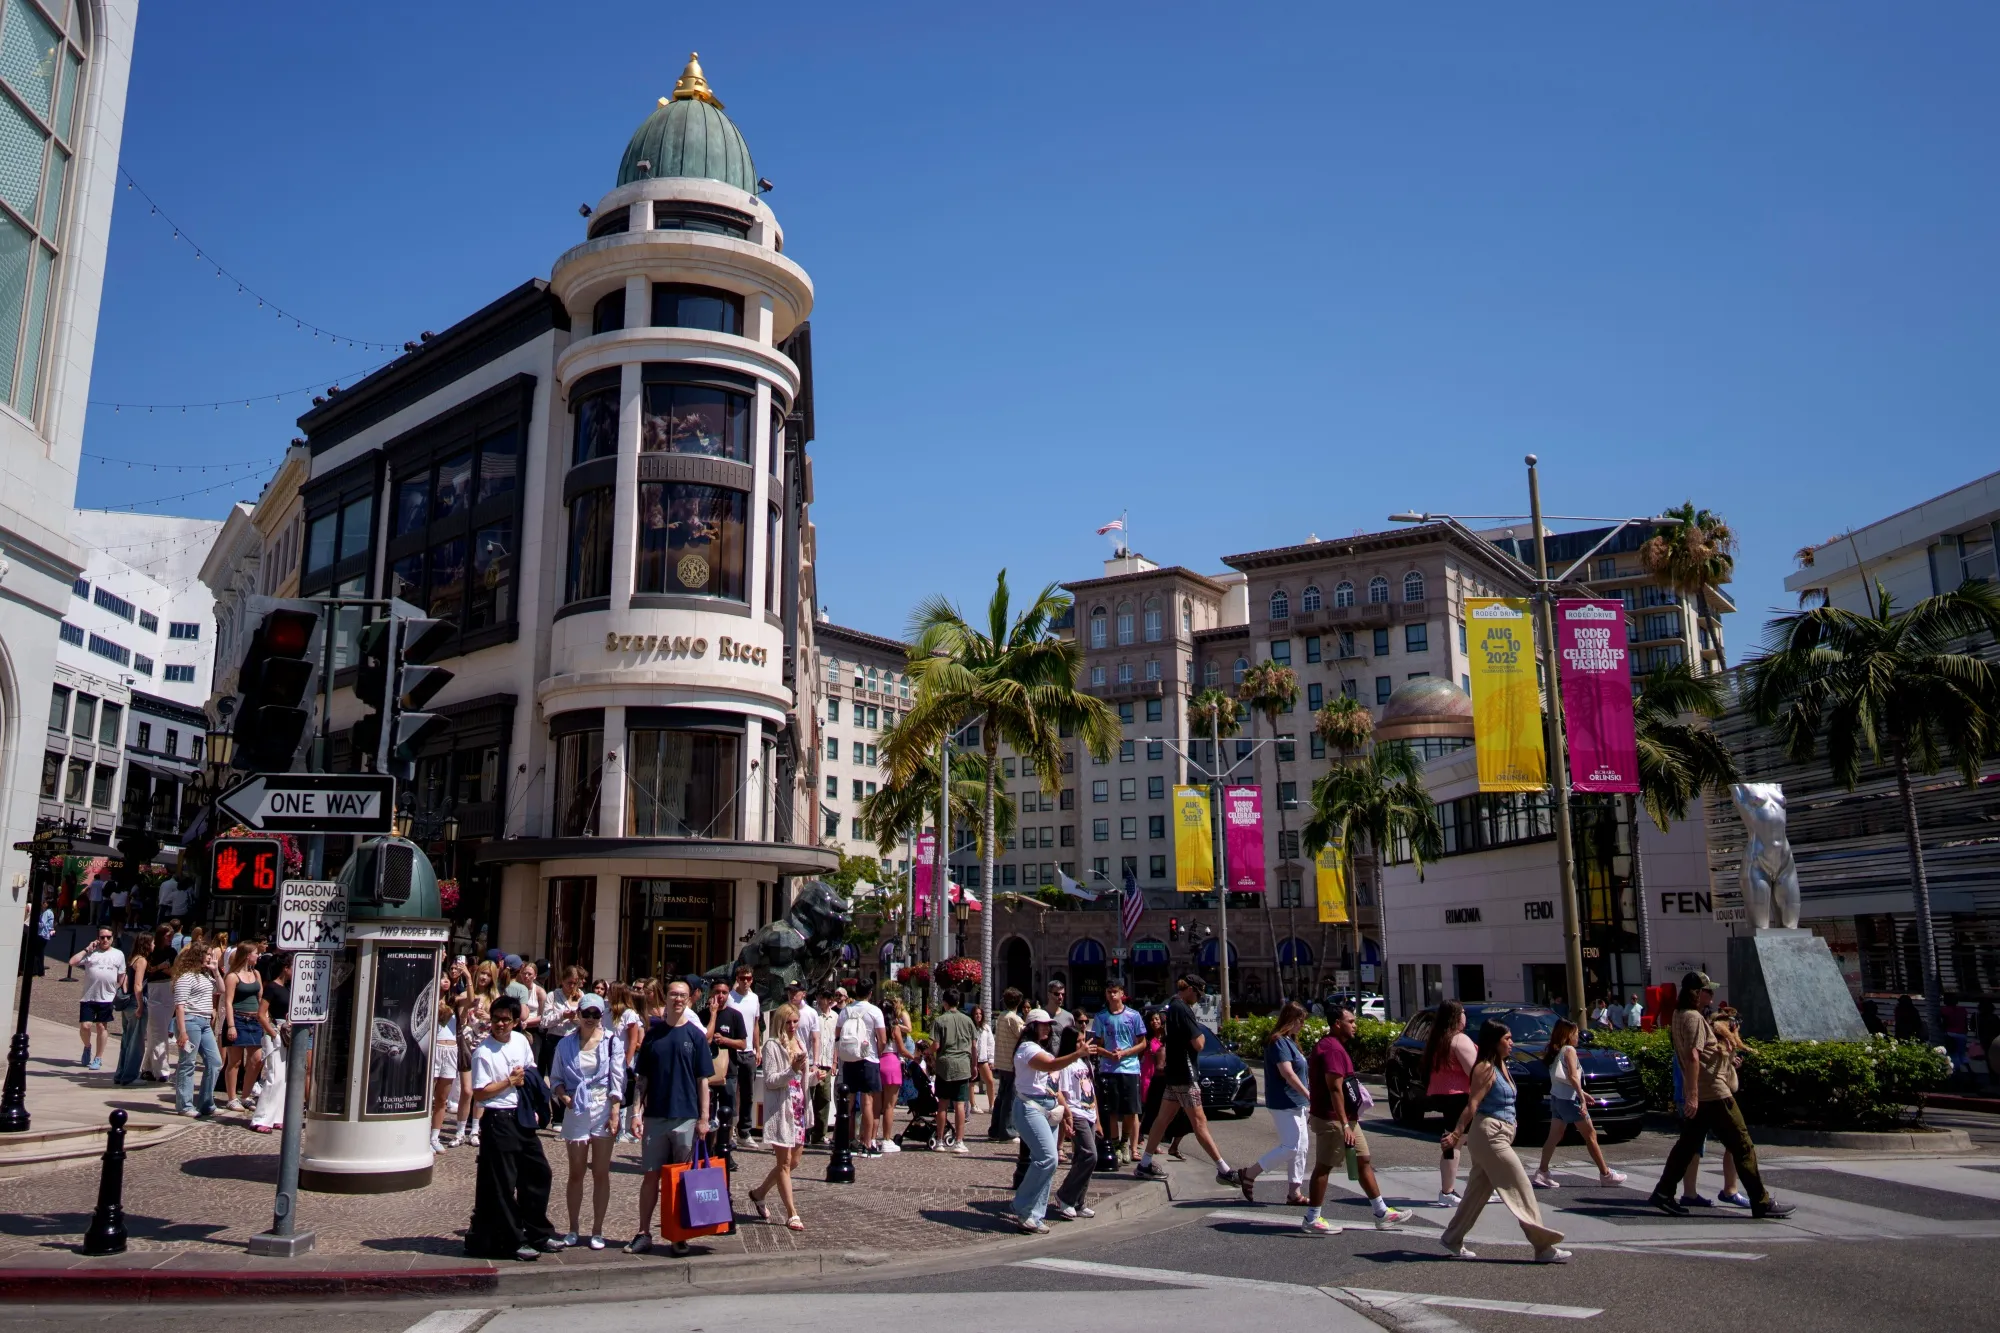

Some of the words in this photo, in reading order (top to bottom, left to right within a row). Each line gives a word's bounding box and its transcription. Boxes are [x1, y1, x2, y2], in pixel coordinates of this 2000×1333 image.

[1487, 628, 1512, 640] AUG
[1574, 627, 1611, 639] RODEO
[605, 631, 709, 653] STEFANO
[719, 635, 768, 664] RICCI
[1480, 640, 1489, 651] 4
[1507, 639, 1521, 651] 10
[1577, 638, 1610, 649] DRIVE
[1486, 652, 1518, 664] 2025
[1563, 648, 1625, 660] CELEBRATES
[1572, 659, 1618, 670] FASHION
[271, 793, 315, 813] ONE
[327, 794, 371, 814] WAY
[252, 852, 275, 890] 16
[286, 884, 345, 898] DIAGONAL
[653, 894, 688, 903] STEFANO
[688, 895, 709, 904] RICCI
[1661, 892, 1712, 914] FEN
[283, 900, 346, 913] CROSSING
[1524, 901, 1554, 920] FENDI
[1445, 907, 1481, 924] RIMOWA
[1716, 909, 1733, 921] LOUIS
[281, 920, 305, 942] OK
[380, 926, 400, 935] TWO
[401, 926, 427, 935] RODEO
[1583, 947, 1600, 958] FENDI
[298, 960, 327, 969] CROSS
[301, 971, 323, 981] ONLY
[305, 983, 317, 992] ON
[298, 995, 322, 1004] WALK
[293, 1007, 324, 1016] SIGNAL
[383, 1095, 404, 1103] Racing
